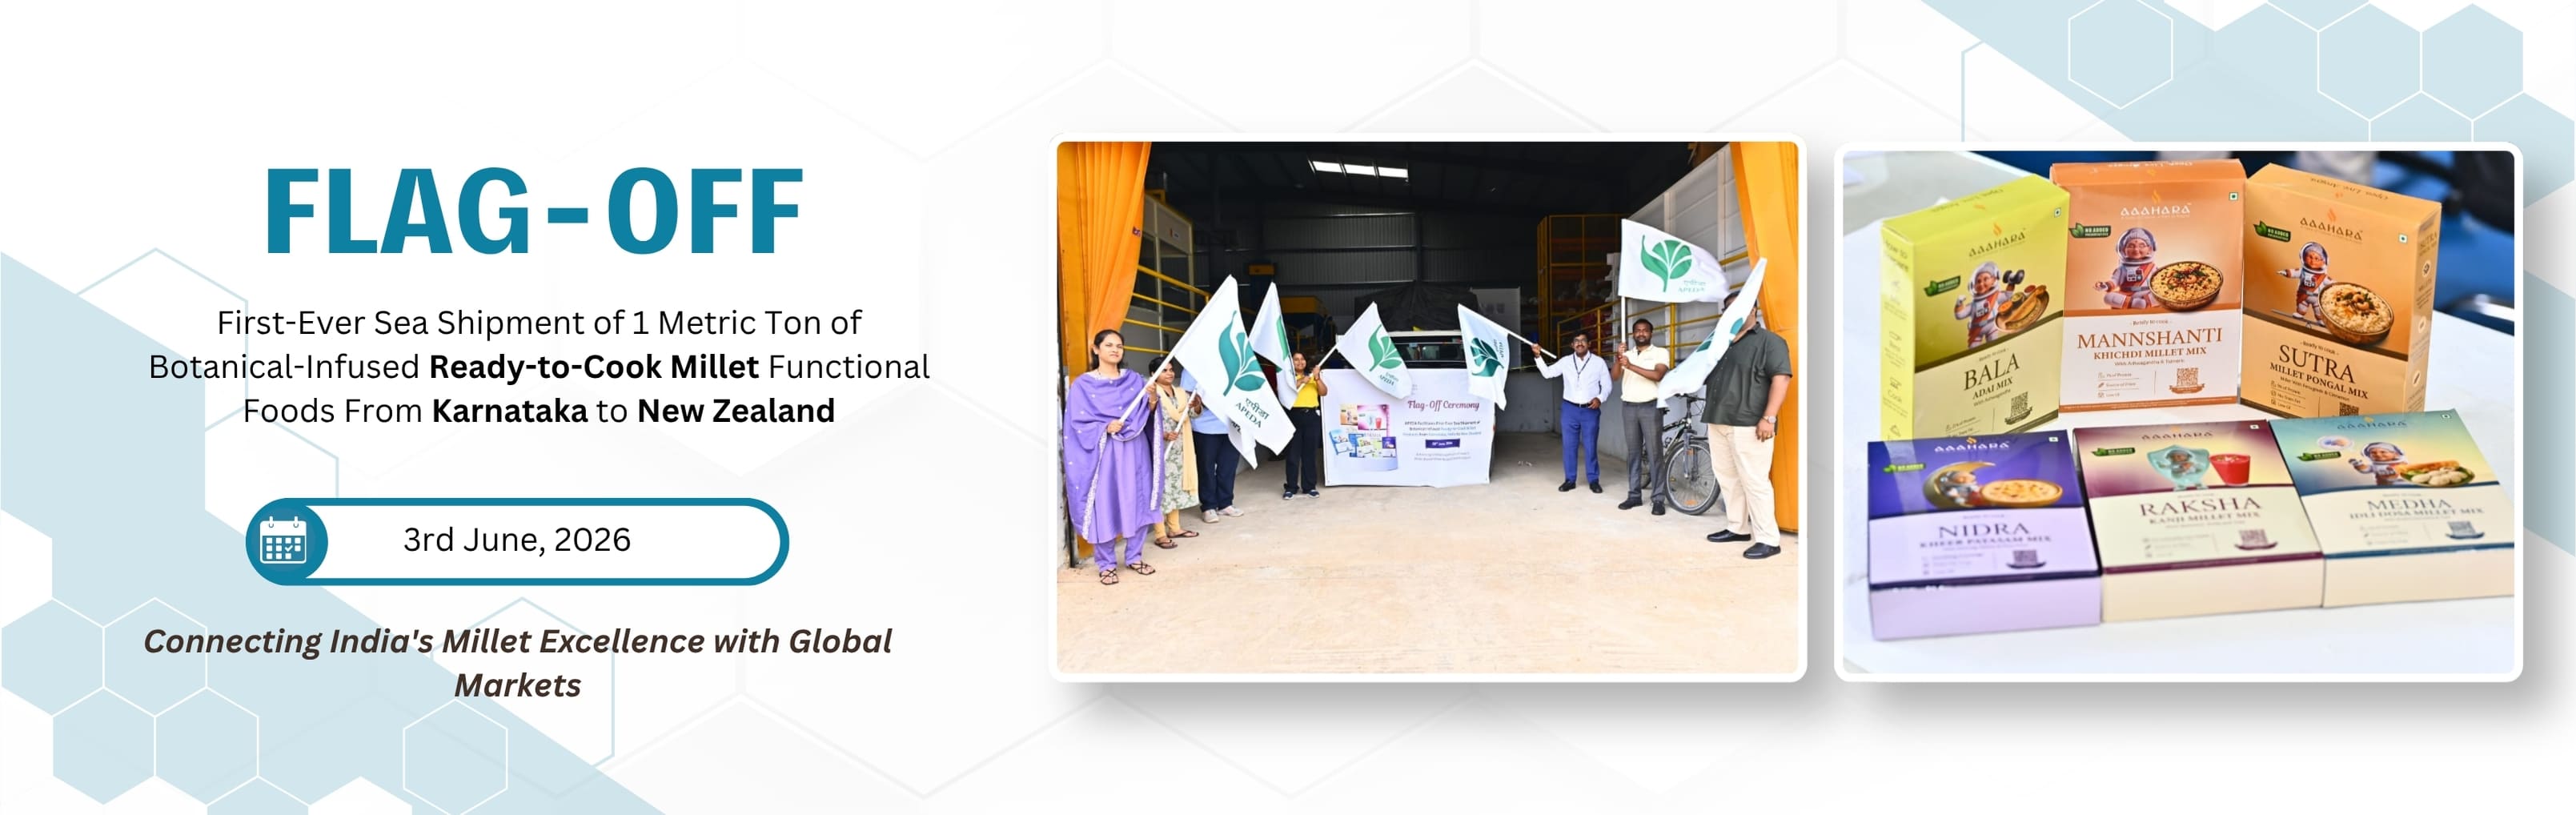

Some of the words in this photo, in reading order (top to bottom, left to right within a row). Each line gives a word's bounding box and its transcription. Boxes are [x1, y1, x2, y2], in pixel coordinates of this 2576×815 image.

[2121, 204, 2190, 217] AAAHARA
[2300, 217, 2363, 241] AAAHARA
[1968, 232, 2026, 257] AAAHARA
[2077, 327, 2223, 348] MANNSHANTI
[2093, 350, 2142, 360] KHICHDI
[2145, 348, 2185, 358] MILLET
[2186, 347, 2208, 355] MIX
[2279, 344, 2356, 383] SUTRA
[1964, 352, 2020, 391] BALA
[2270, 363, 2305, 379] MILLET
[2306, 374, 2346, 394] PONGAL
[2348, 387, 2369, 399] MIX
[1972, 385, 1996, 399] ADAI
[1996, 376, 2014, 391] MIX
[1236, 403, 1262, 428] APEDA
[1246, 398, 1270, 420] एपीडा
[1442, 400, 1480, 412] Ceremony
[1935, 443, 2009, 452] AAAHARA
[2141, 496, 2261, 516] RAKSHA
[2368, 499, 2452, 511] MEDHA
[2189, 514, 2232, 522] MILLET
[1939, 522, 2030, 538] NIDRA
